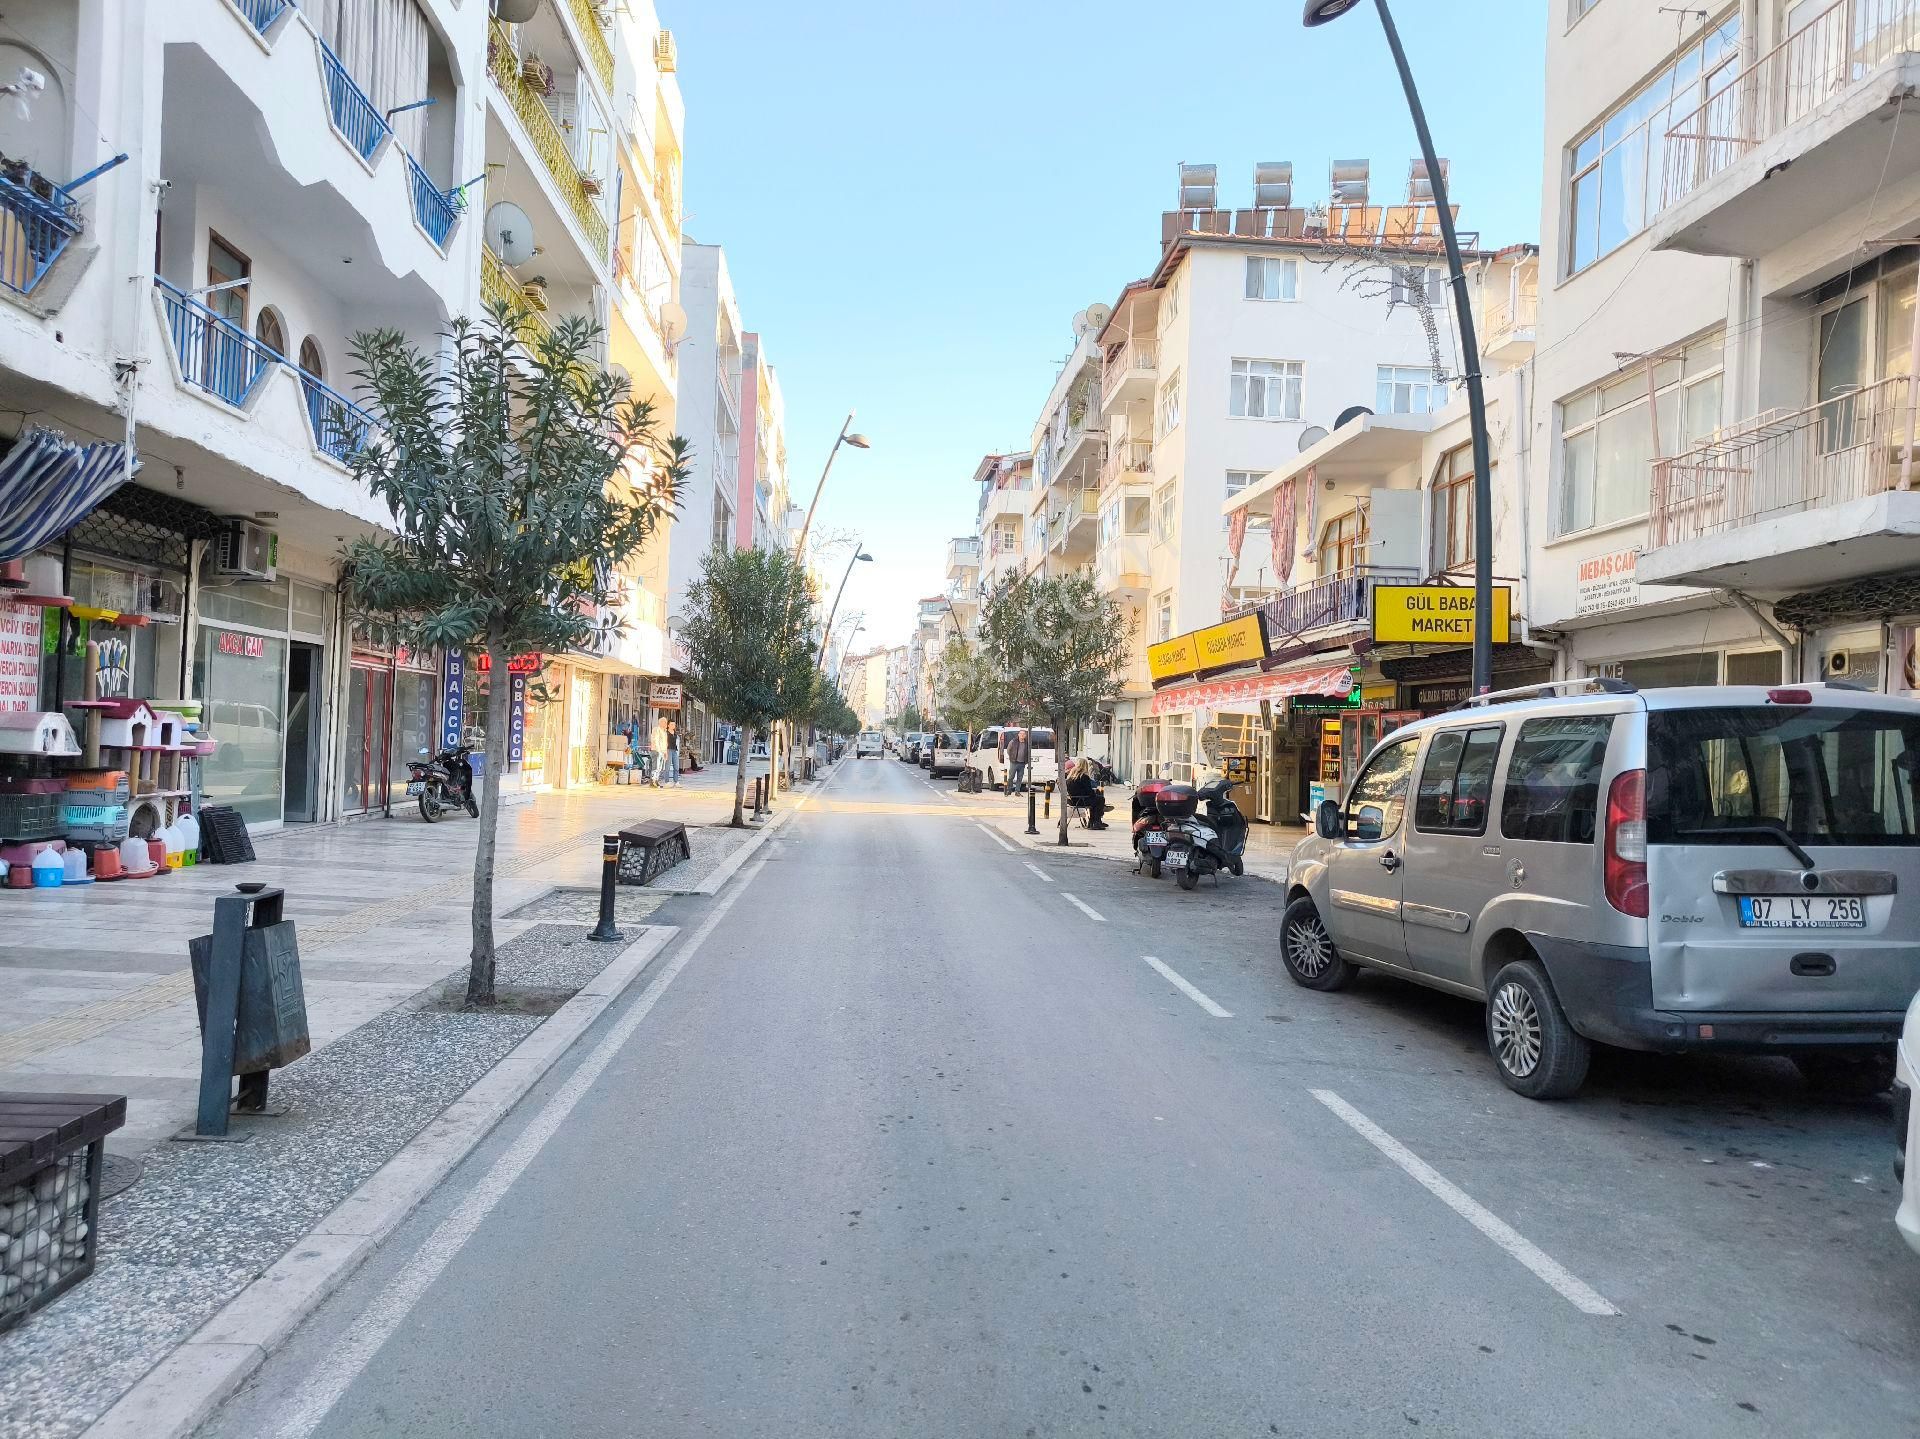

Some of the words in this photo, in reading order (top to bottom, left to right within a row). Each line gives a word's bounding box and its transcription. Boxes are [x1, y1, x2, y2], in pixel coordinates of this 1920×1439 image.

[1580, 555, 1612, 582] MEBAŞ
[1406, 593, 1435, 611] GÜL
[1412, 618, 1473, 633] MARKET
[1, 640, 22, 656] NARYA
[245, 636, 264, 657] CAM
[447, 647, 462, 745] OBACCO
[512, 679, 524, 758] OBACCO
[1752, 898, 1772, 919] 07
[1790, 898, 1811, 919] LY
[1828, 898, 1860, 919] 256
[1796, 920, 1818, 928] OTO
